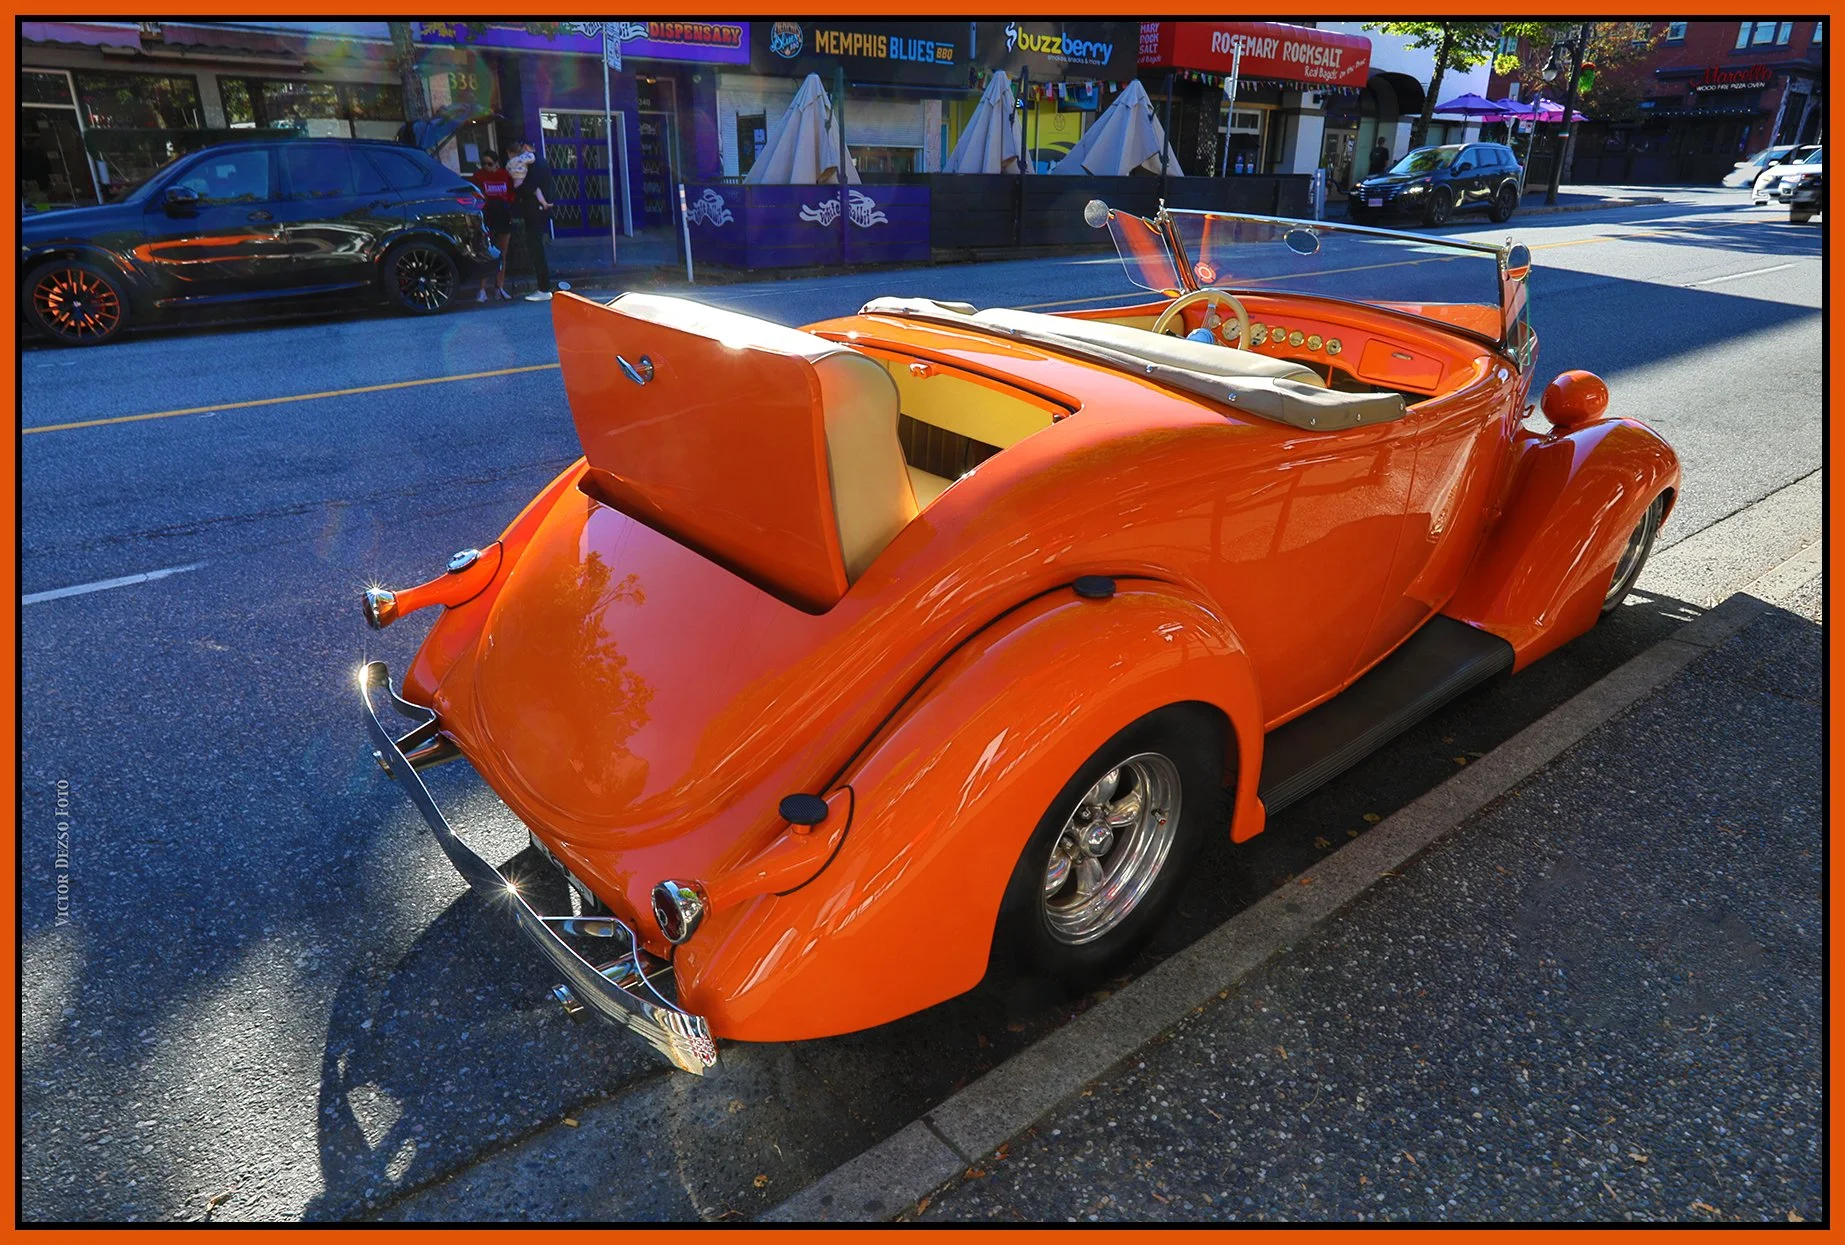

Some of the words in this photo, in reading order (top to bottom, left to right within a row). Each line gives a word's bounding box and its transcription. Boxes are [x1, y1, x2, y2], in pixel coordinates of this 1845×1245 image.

[649, 22, 741, 46] DISPENSARY
[1140, 22, 1160, 34] MARY
[815, 29, 887, 58] MEMPHIS
[890, 36, 934, 63] BLUES
[935, 46, 952, 61] BBQ
[1017, 26, 1113, 65] buzzberry
[1139, 43, 1159, 55] SALT
[1211, 31, 1280, 60] ROSEMARY
[1282, 40, 1343, 68] ROCKSALT
[1747, 81, 1766, 89] OVEN
